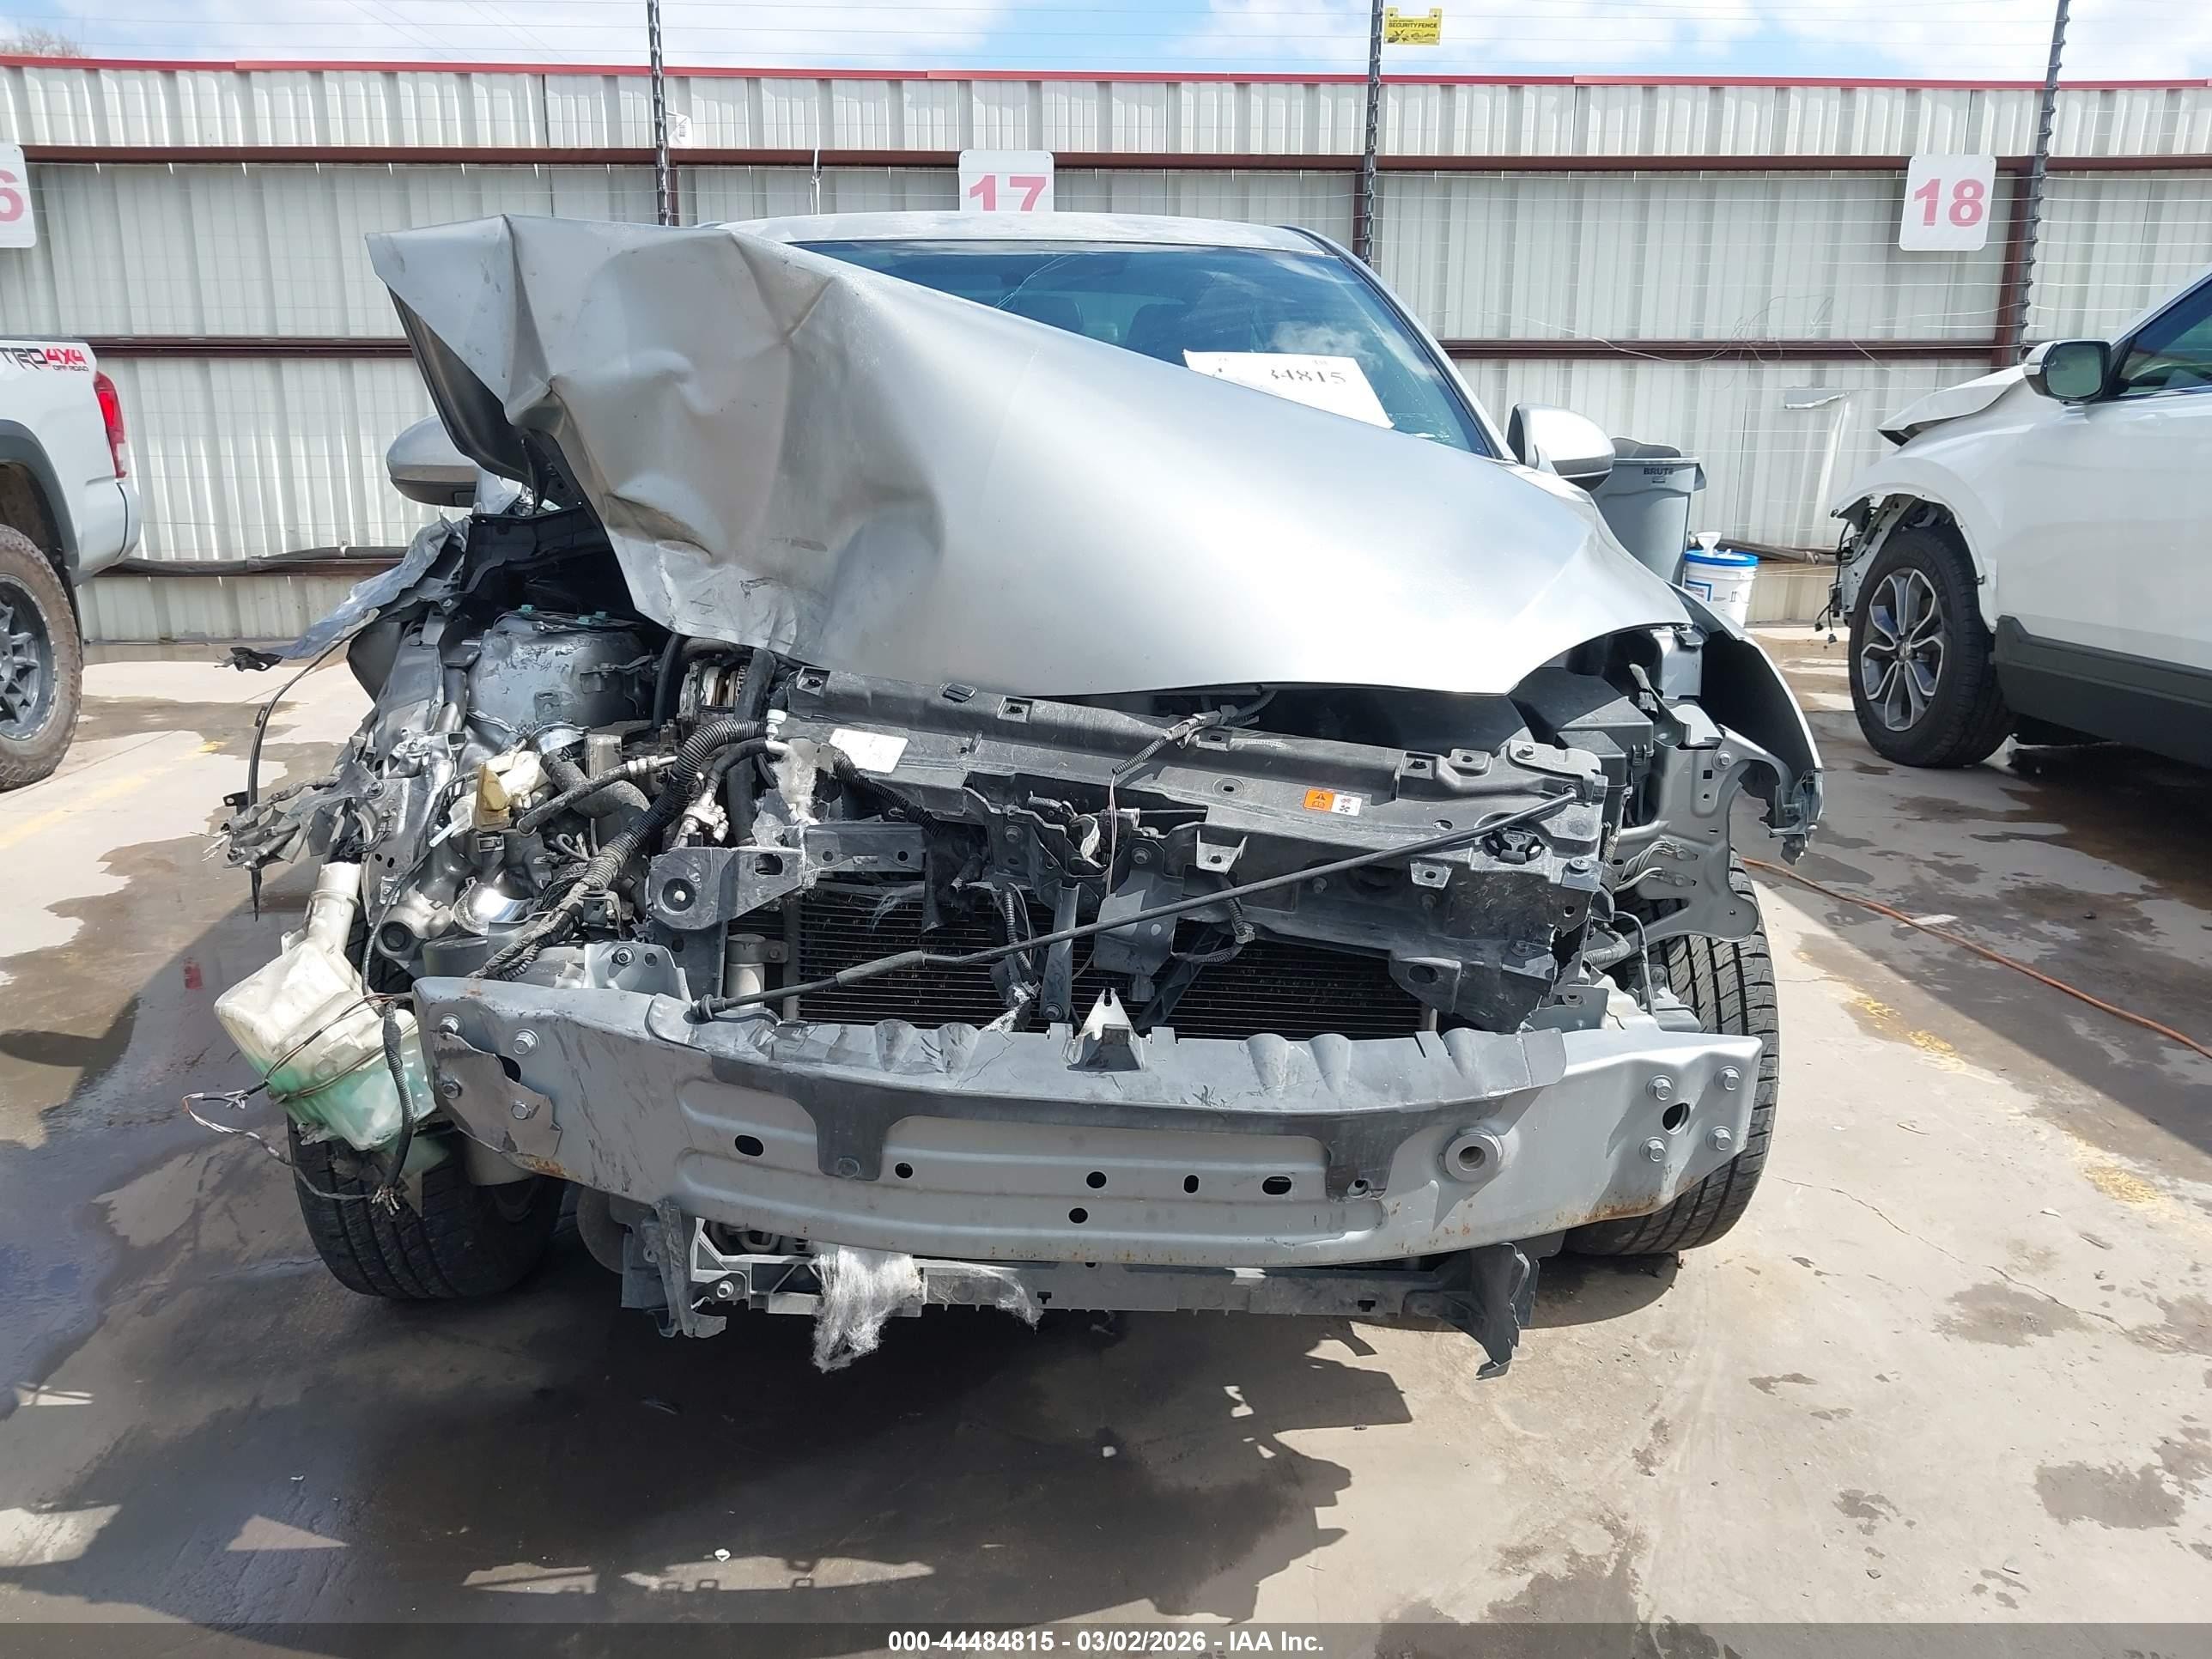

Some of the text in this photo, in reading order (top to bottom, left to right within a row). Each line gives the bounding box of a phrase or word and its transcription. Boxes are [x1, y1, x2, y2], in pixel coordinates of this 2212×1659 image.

[969, 174, 1047, 211] 17
[1914, 179, 1984, 227] 18
[0, 347, 49, 371] TRD
[1644, 466, 1674, 476] BRUTE
